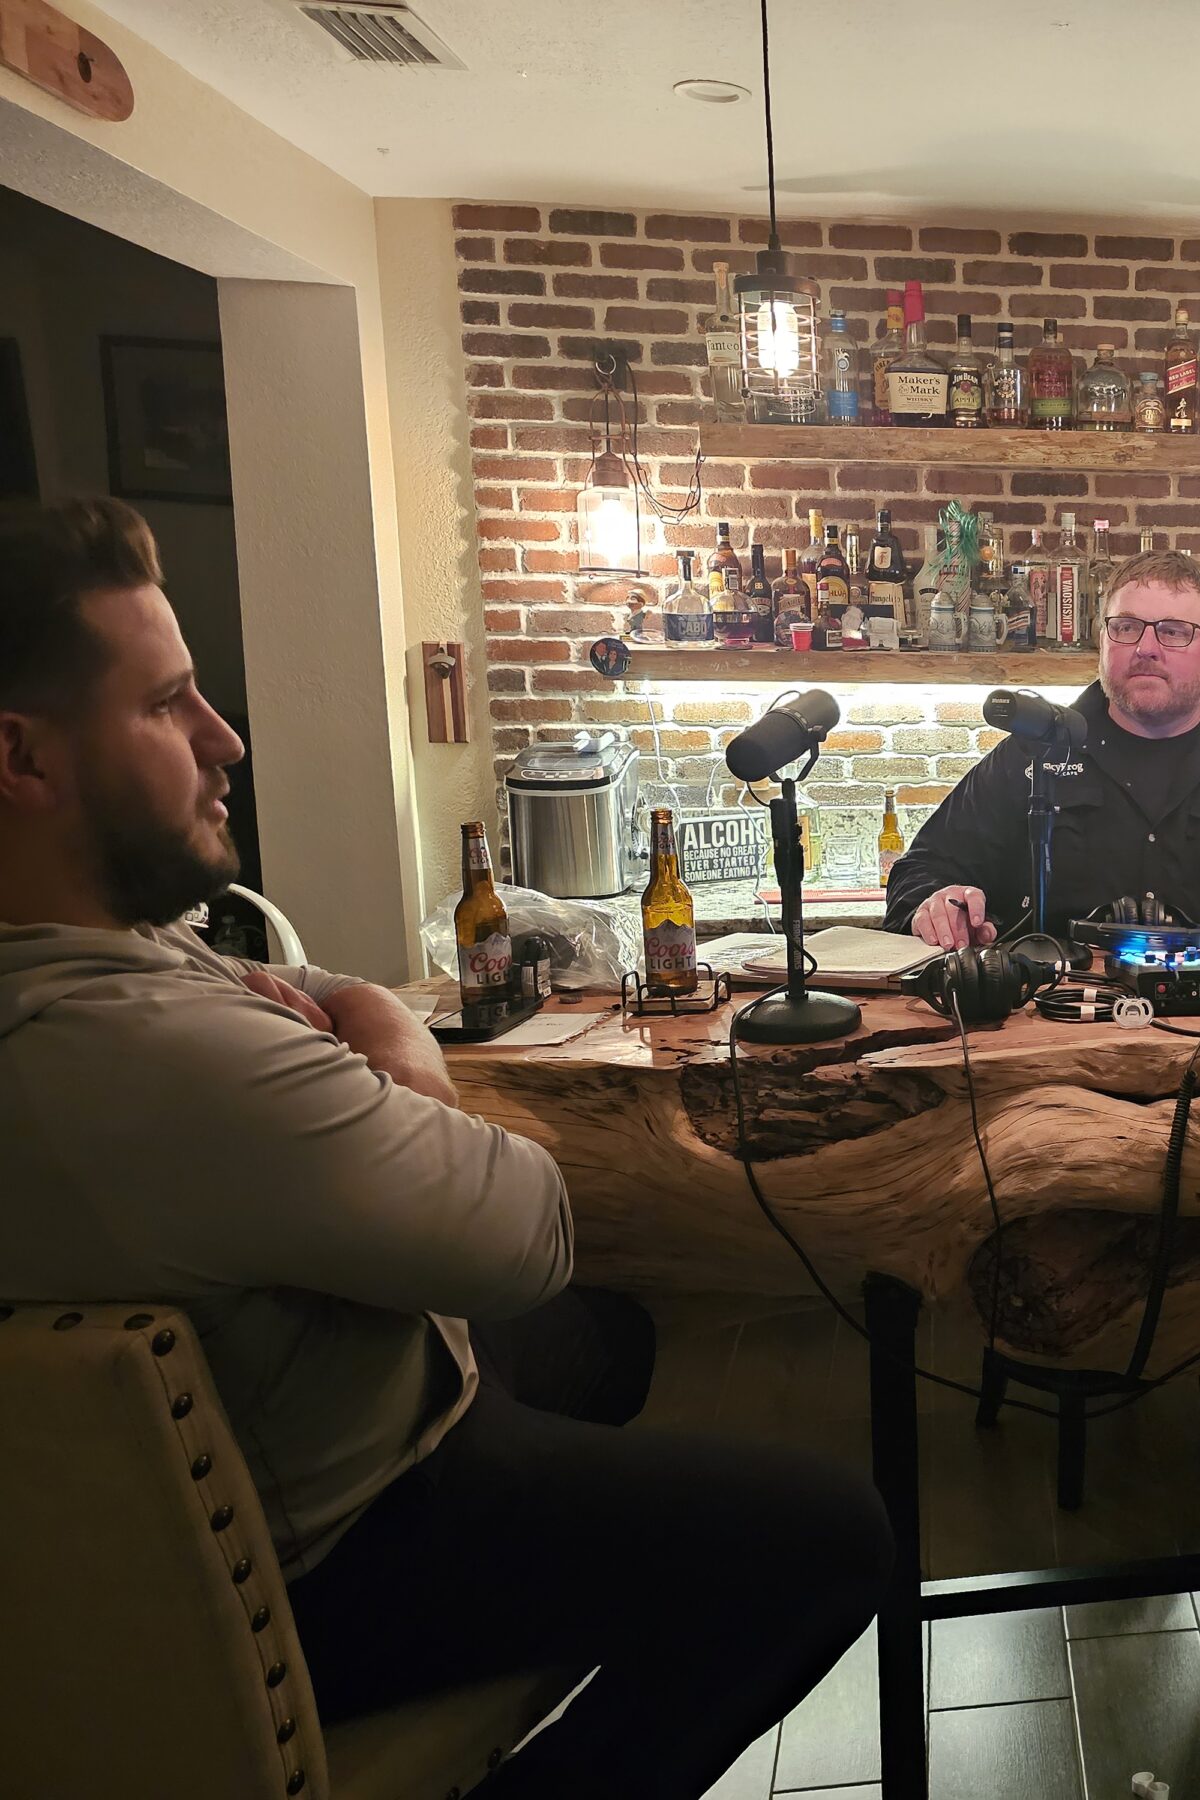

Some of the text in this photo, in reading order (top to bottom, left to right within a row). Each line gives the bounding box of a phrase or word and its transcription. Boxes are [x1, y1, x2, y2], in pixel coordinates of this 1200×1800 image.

[1180, 368, 1196, 377] LABEL
[898, 376, 940, 385] Maker's
[910, 386, 940, 395] Mark
[1062, 579, 1073, 630] LUKSUSOWA
[683, 818, 767, 851] ALCOHO
[683, 848, 719, 861] BECAUSE
[720, 847, 732, 857] NO
[732, 845, 757, 856] GREAT
[684, 859, 709, 871] EVER
[713, 856, 755, 868] STARTED
[684, 868, 722, 882] SOMEONE
[724, 867, 750, 878] EATING
[646, 937, 694, 957] Coors
[469, 952, 512, 972] Coor
[650, 956, 692, 969] LIGHT
[476, 970, 510, 984] LIGH
